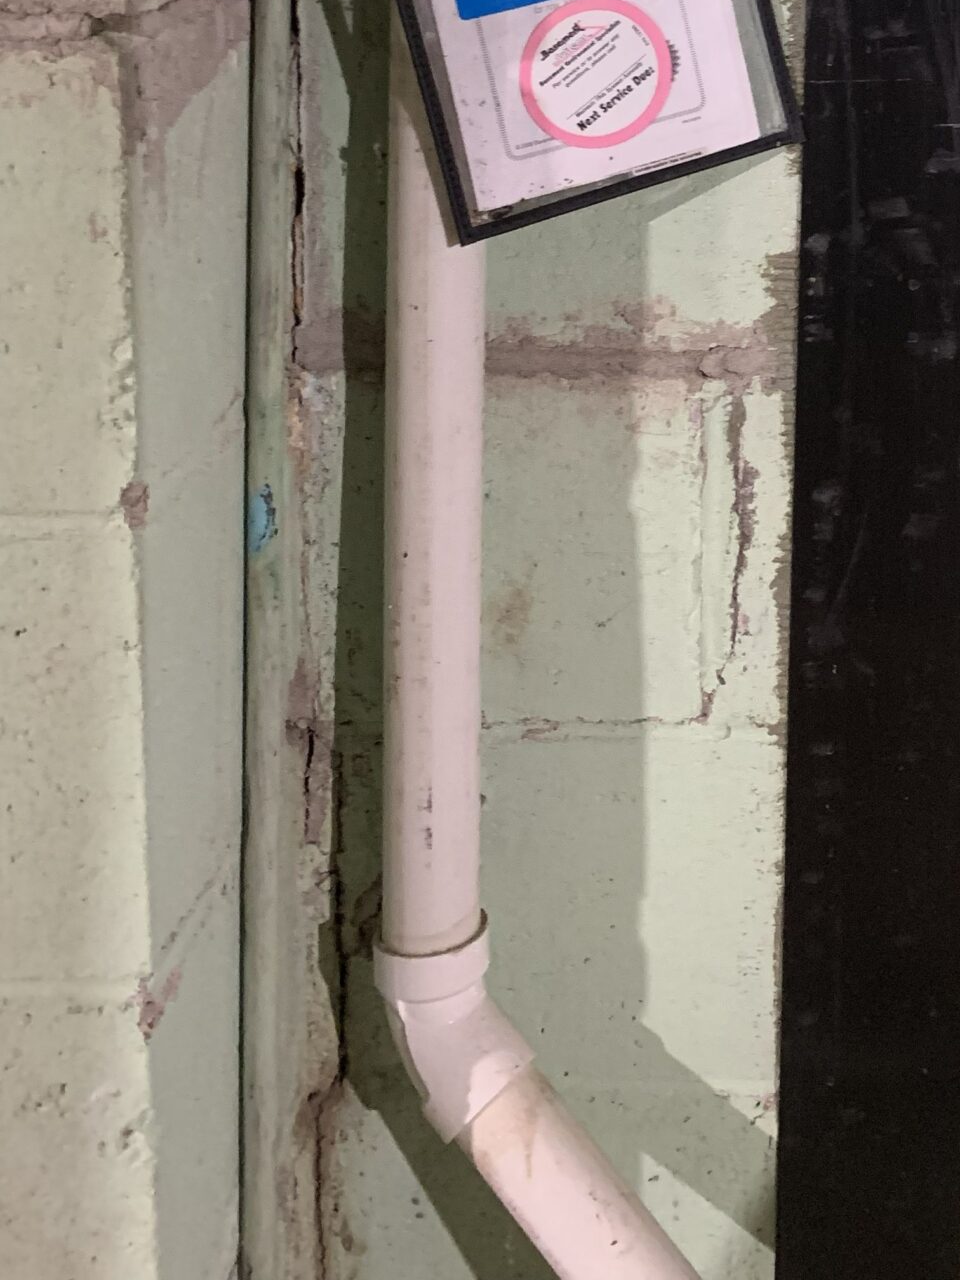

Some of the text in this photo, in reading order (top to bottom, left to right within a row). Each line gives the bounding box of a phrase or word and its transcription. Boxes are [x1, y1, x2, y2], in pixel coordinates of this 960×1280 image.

[577, 66, 655, 131] Next Service Due:
